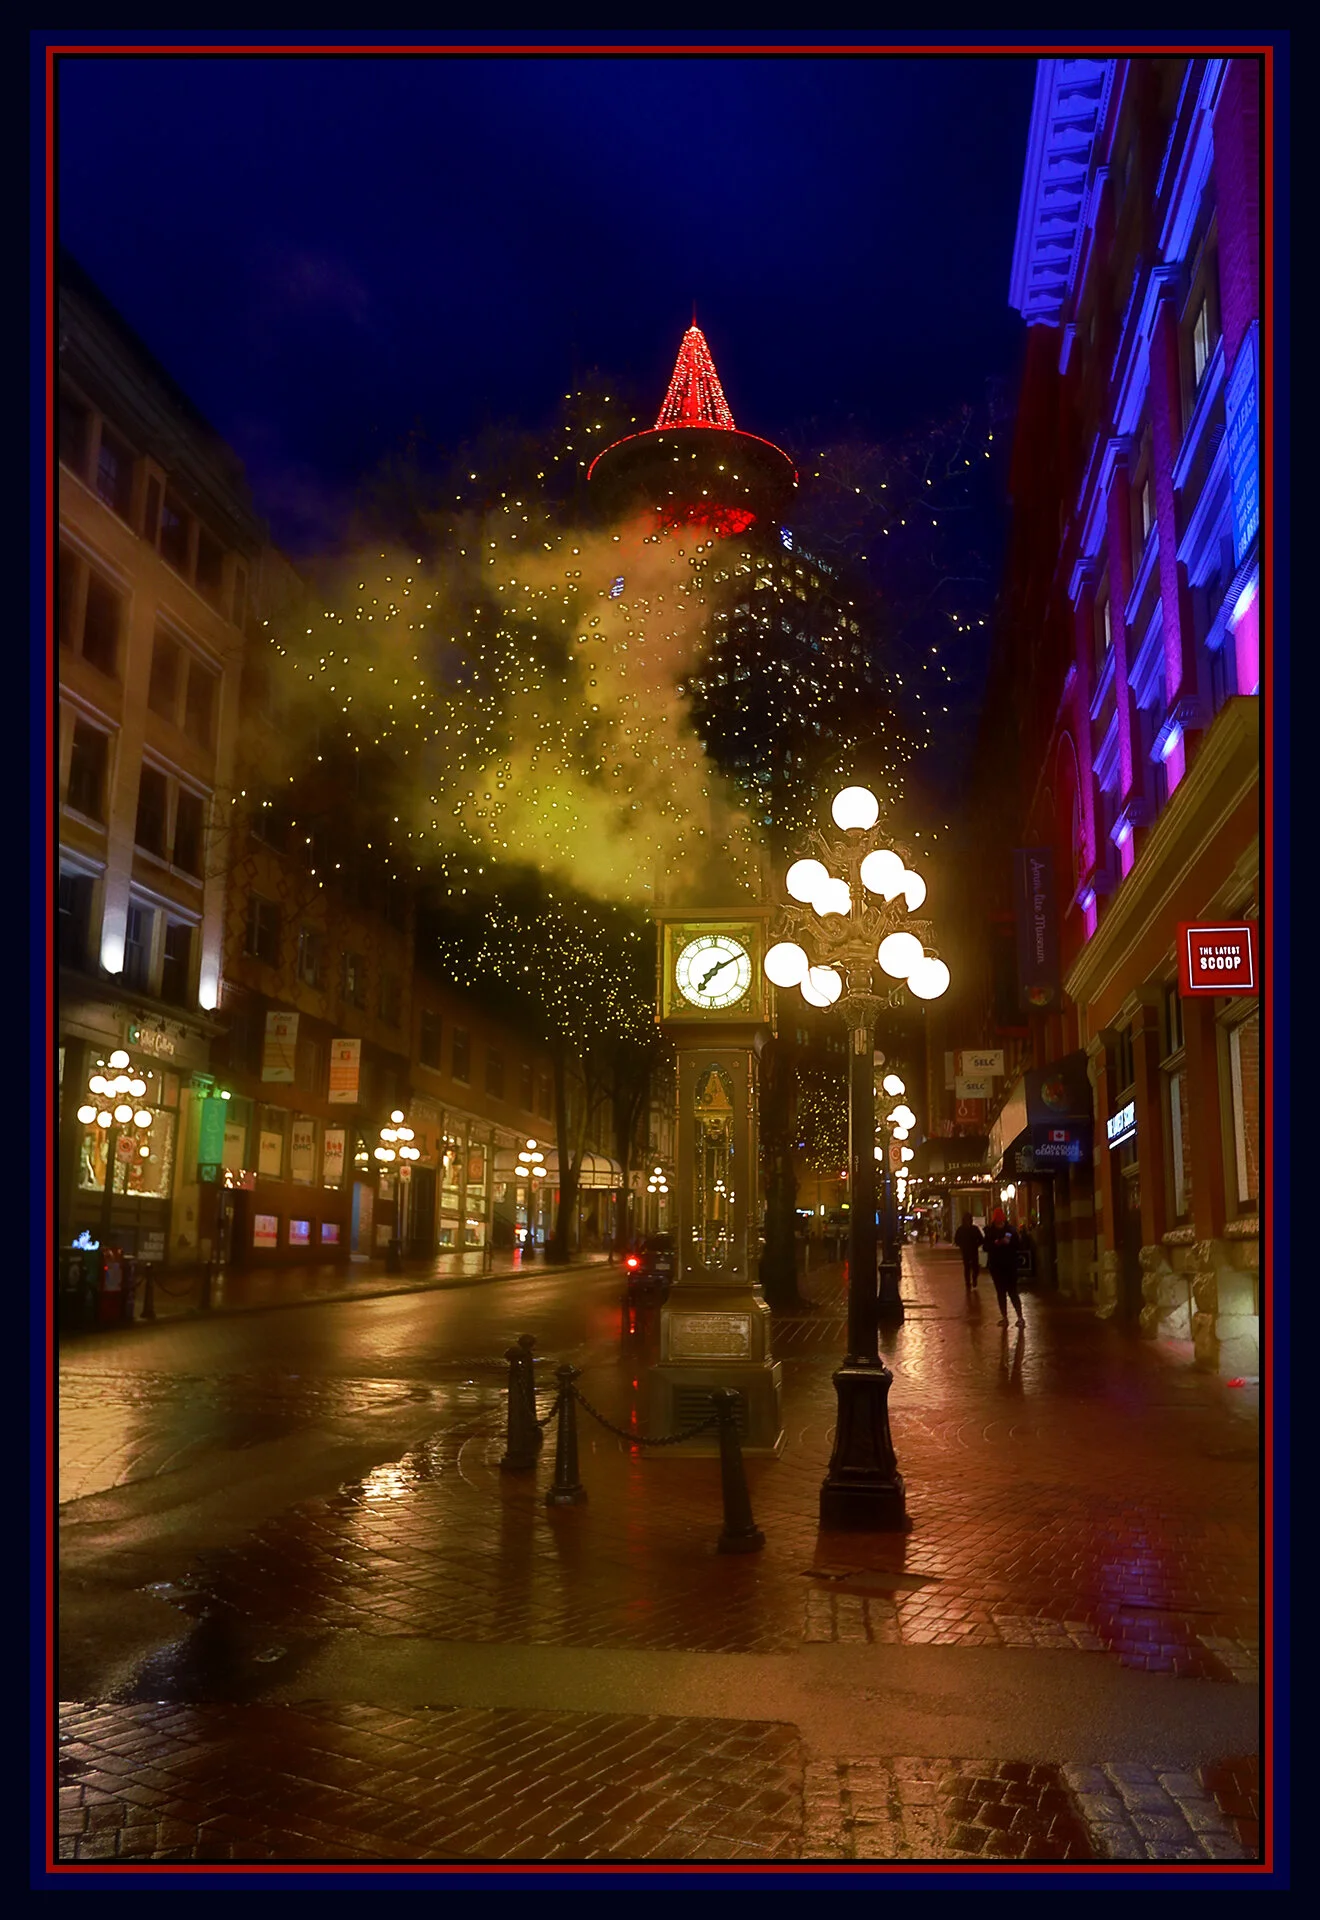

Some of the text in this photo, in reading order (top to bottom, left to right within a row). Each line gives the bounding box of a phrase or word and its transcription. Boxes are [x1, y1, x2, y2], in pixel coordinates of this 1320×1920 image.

[1033, 913, 1046, 965] Museum
[1199, 946, 1240, 955] THE LATEST
[1200, 956, 1241, 970] SCOOP
[974, 1059, 995, 1067] SELC
